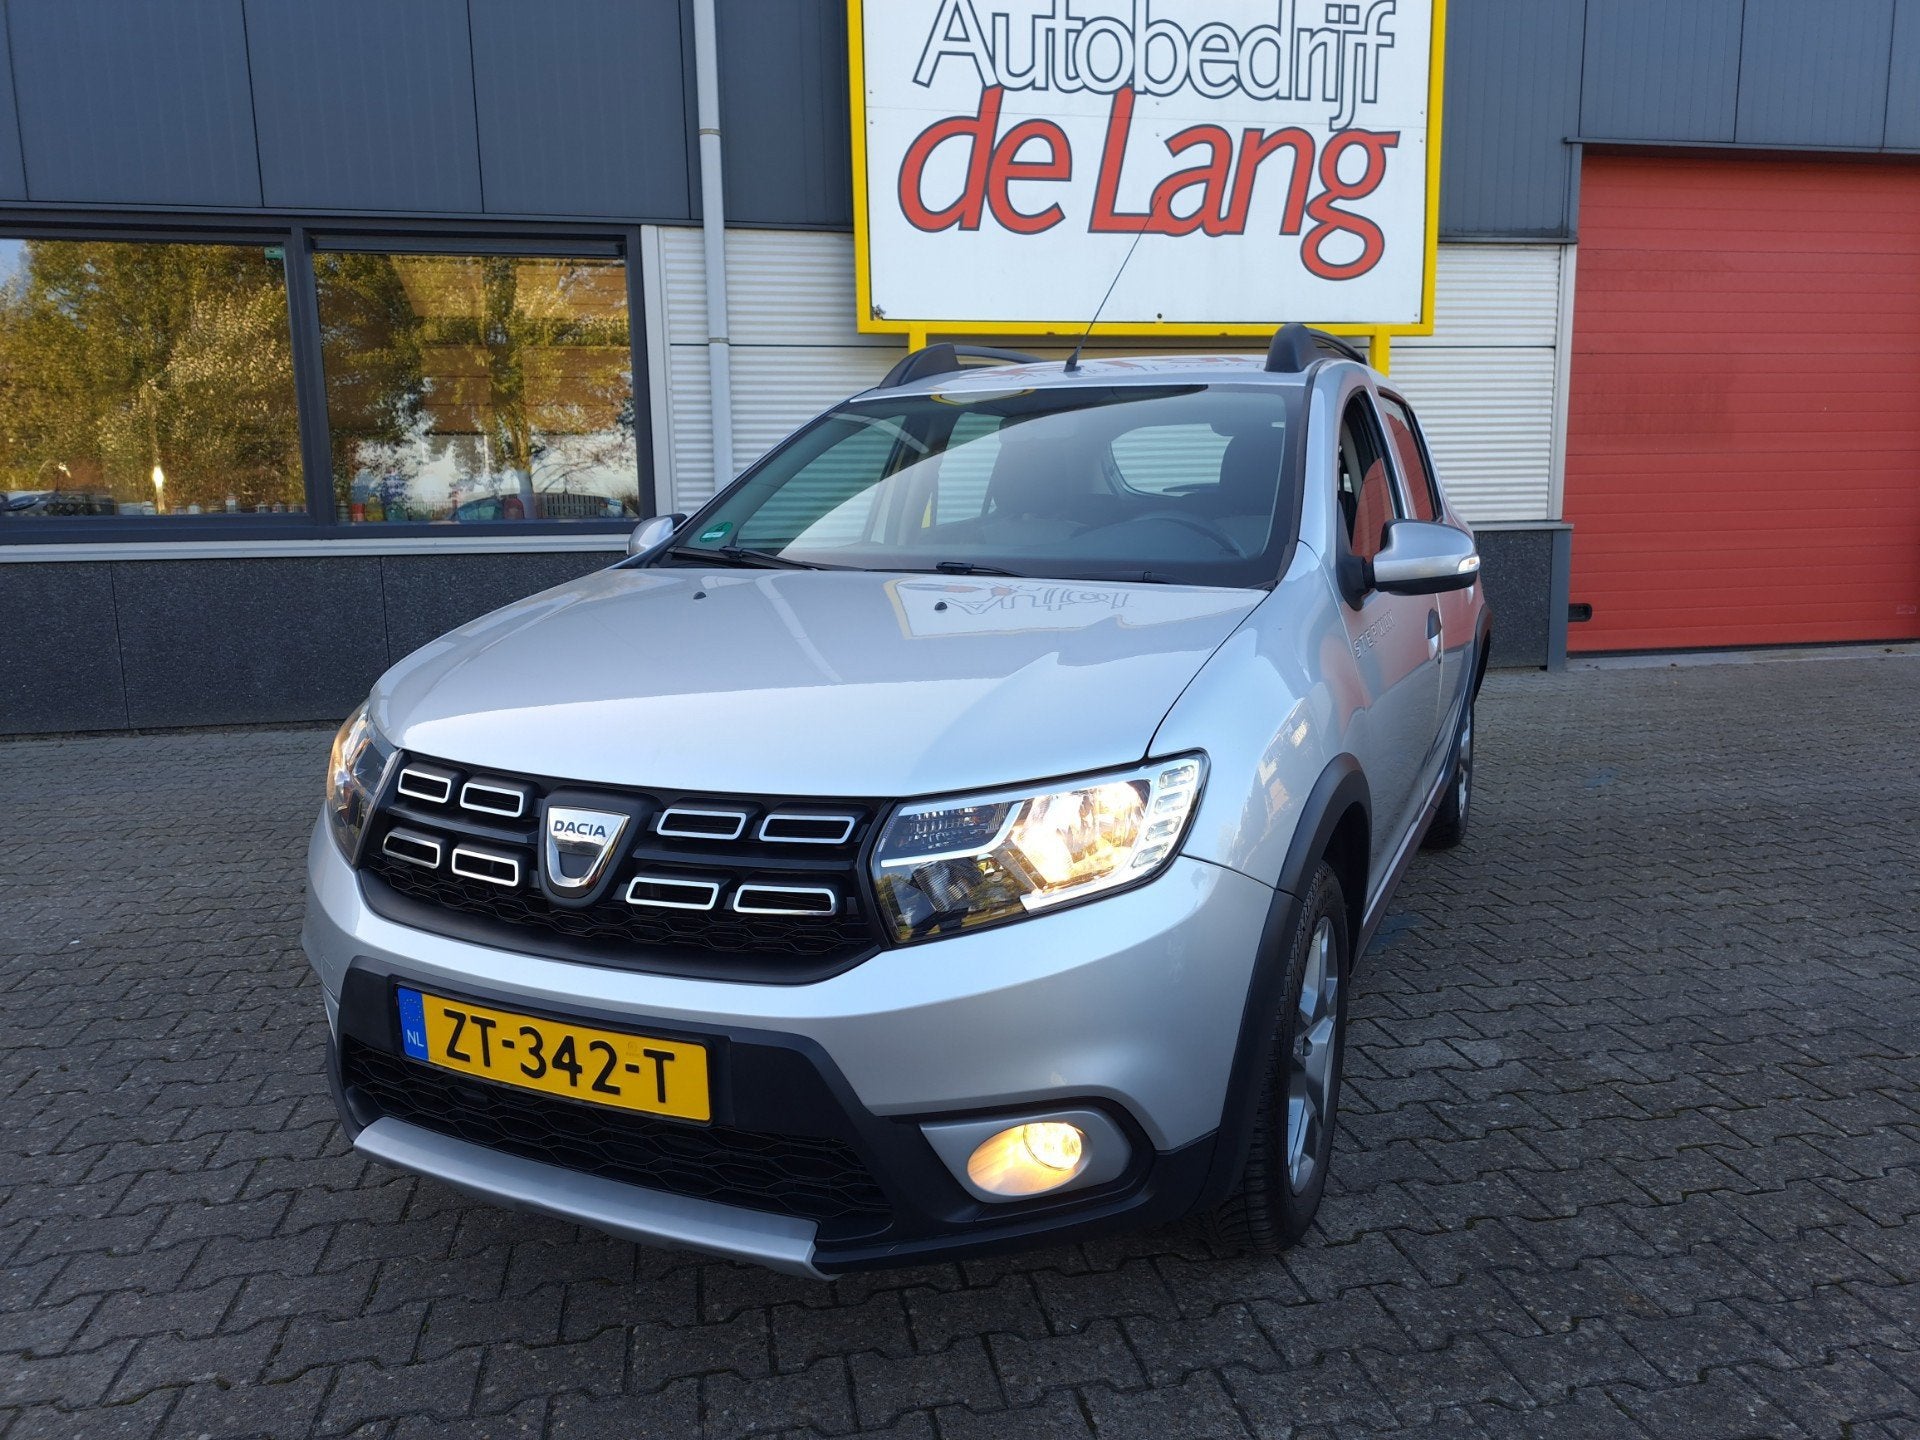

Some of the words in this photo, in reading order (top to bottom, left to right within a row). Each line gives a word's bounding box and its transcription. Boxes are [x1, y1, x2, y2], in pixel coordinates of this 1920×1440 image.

[913, 0, 1396, 132] Autobedrijf
[899, 85, 1072, 235] de
[1088, 85, 1400, 280] Lang
[553, 820, 606, 838] DACIA
[406, 1029, 425, 1048] NL
[443, 1008, 675, 1104] ZT-342-T
